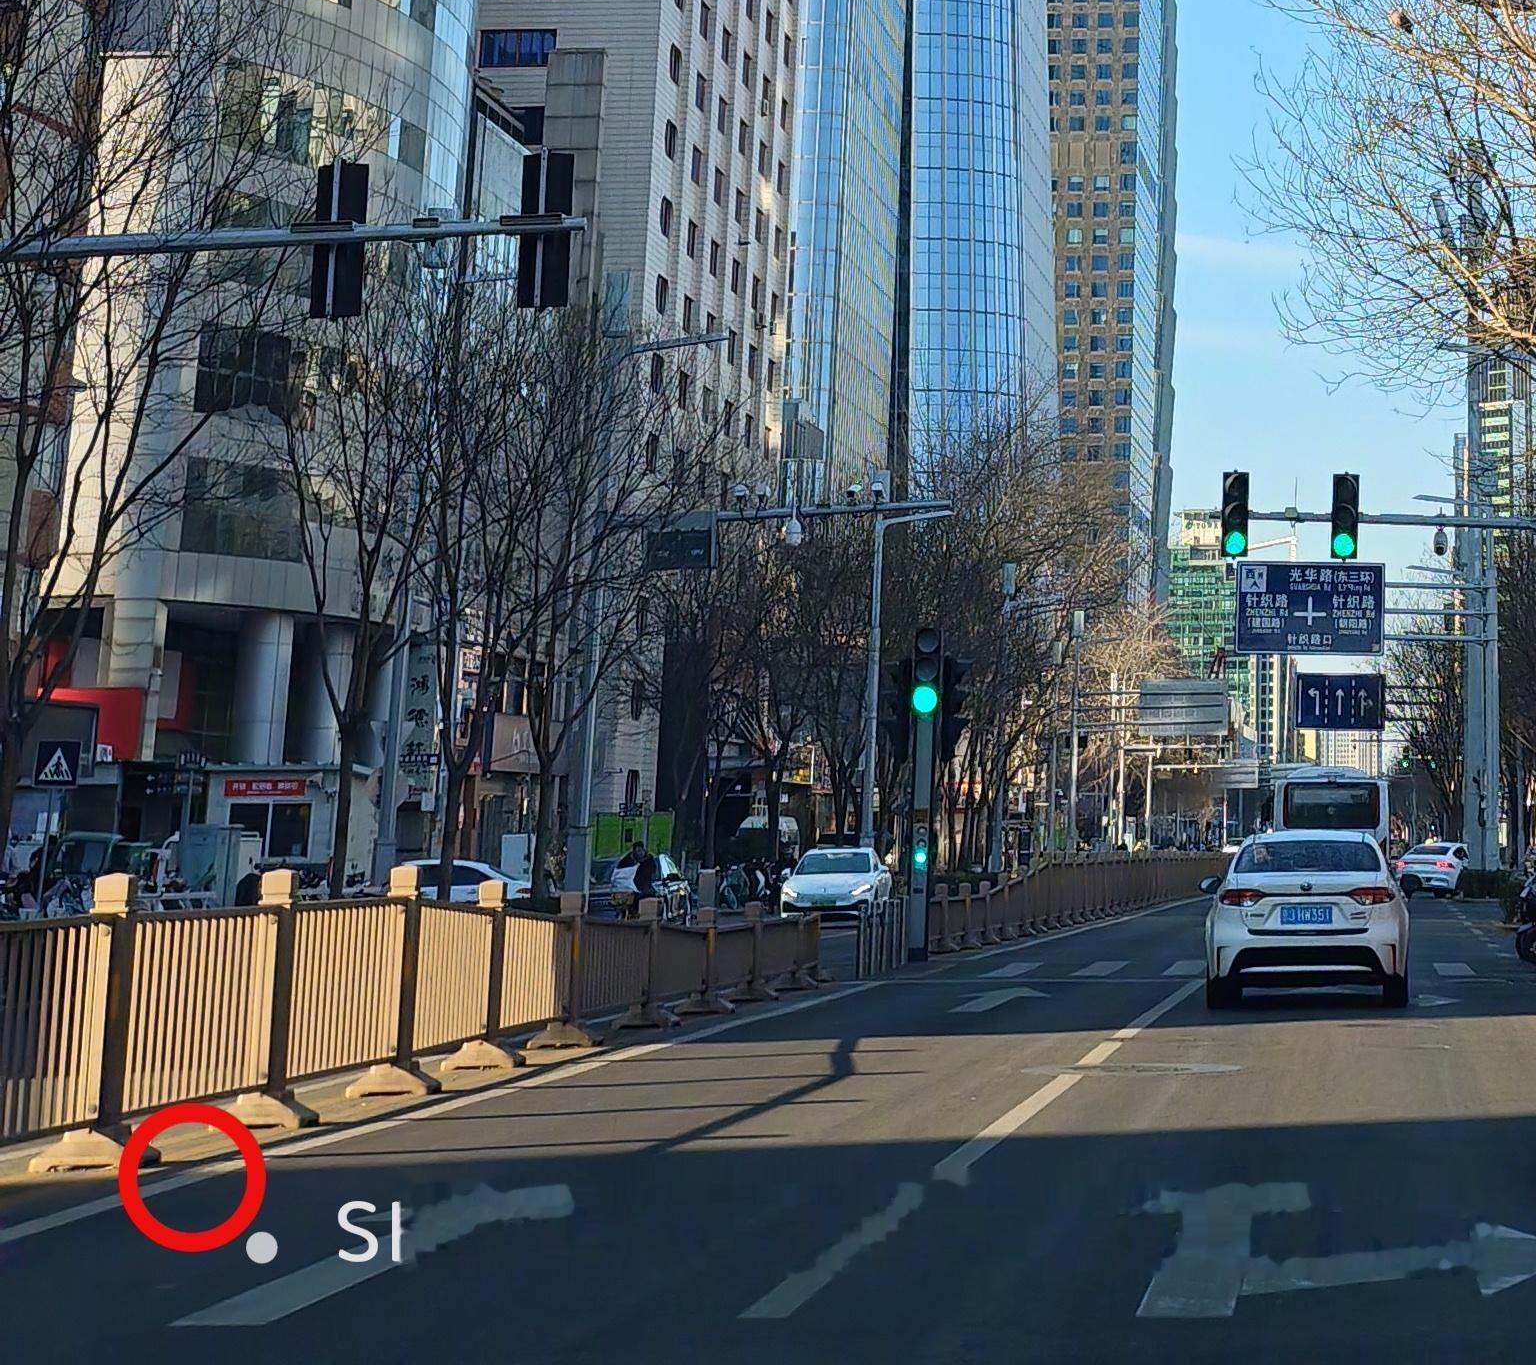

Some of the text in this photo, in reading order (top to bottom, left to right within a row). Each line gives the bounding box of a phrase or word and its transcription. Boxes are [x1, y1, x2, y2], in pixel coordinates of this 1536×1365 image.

[1246, 593, 1289, 608] 针织路
[1332, 594, 1375, 609] 针织路
